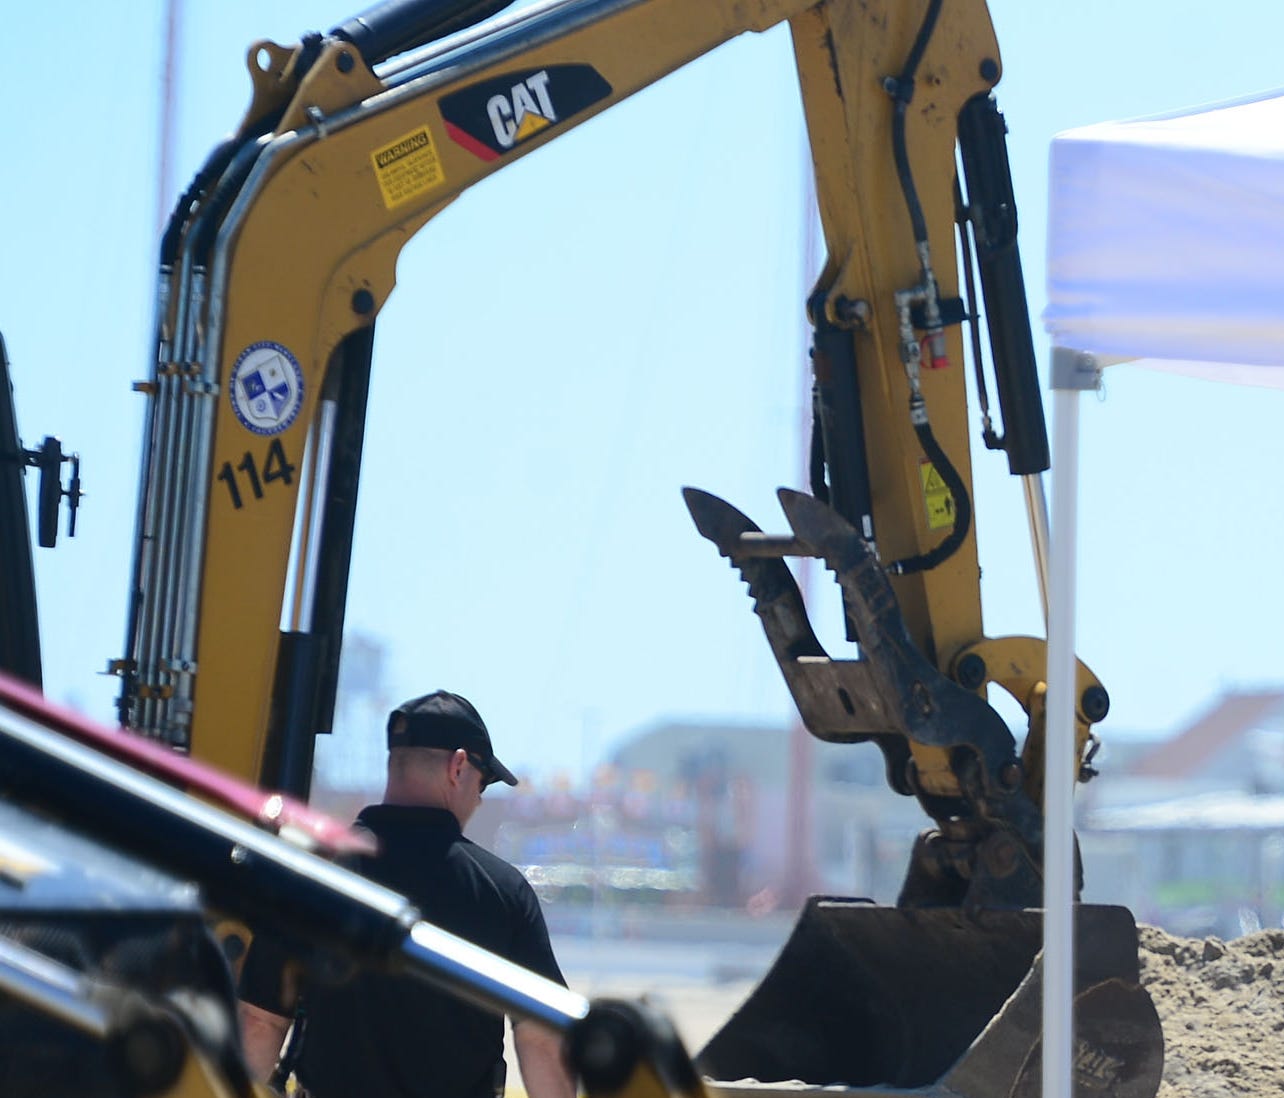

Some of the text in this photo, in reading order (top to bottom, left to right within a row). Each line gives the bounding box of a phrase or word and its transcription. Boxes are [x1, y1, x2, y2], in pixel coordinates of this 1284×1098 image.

[486, 70, 557, 148] CAT
[377, 132, 428, 167] WARNING
[217, 438, 295, 509] 114
